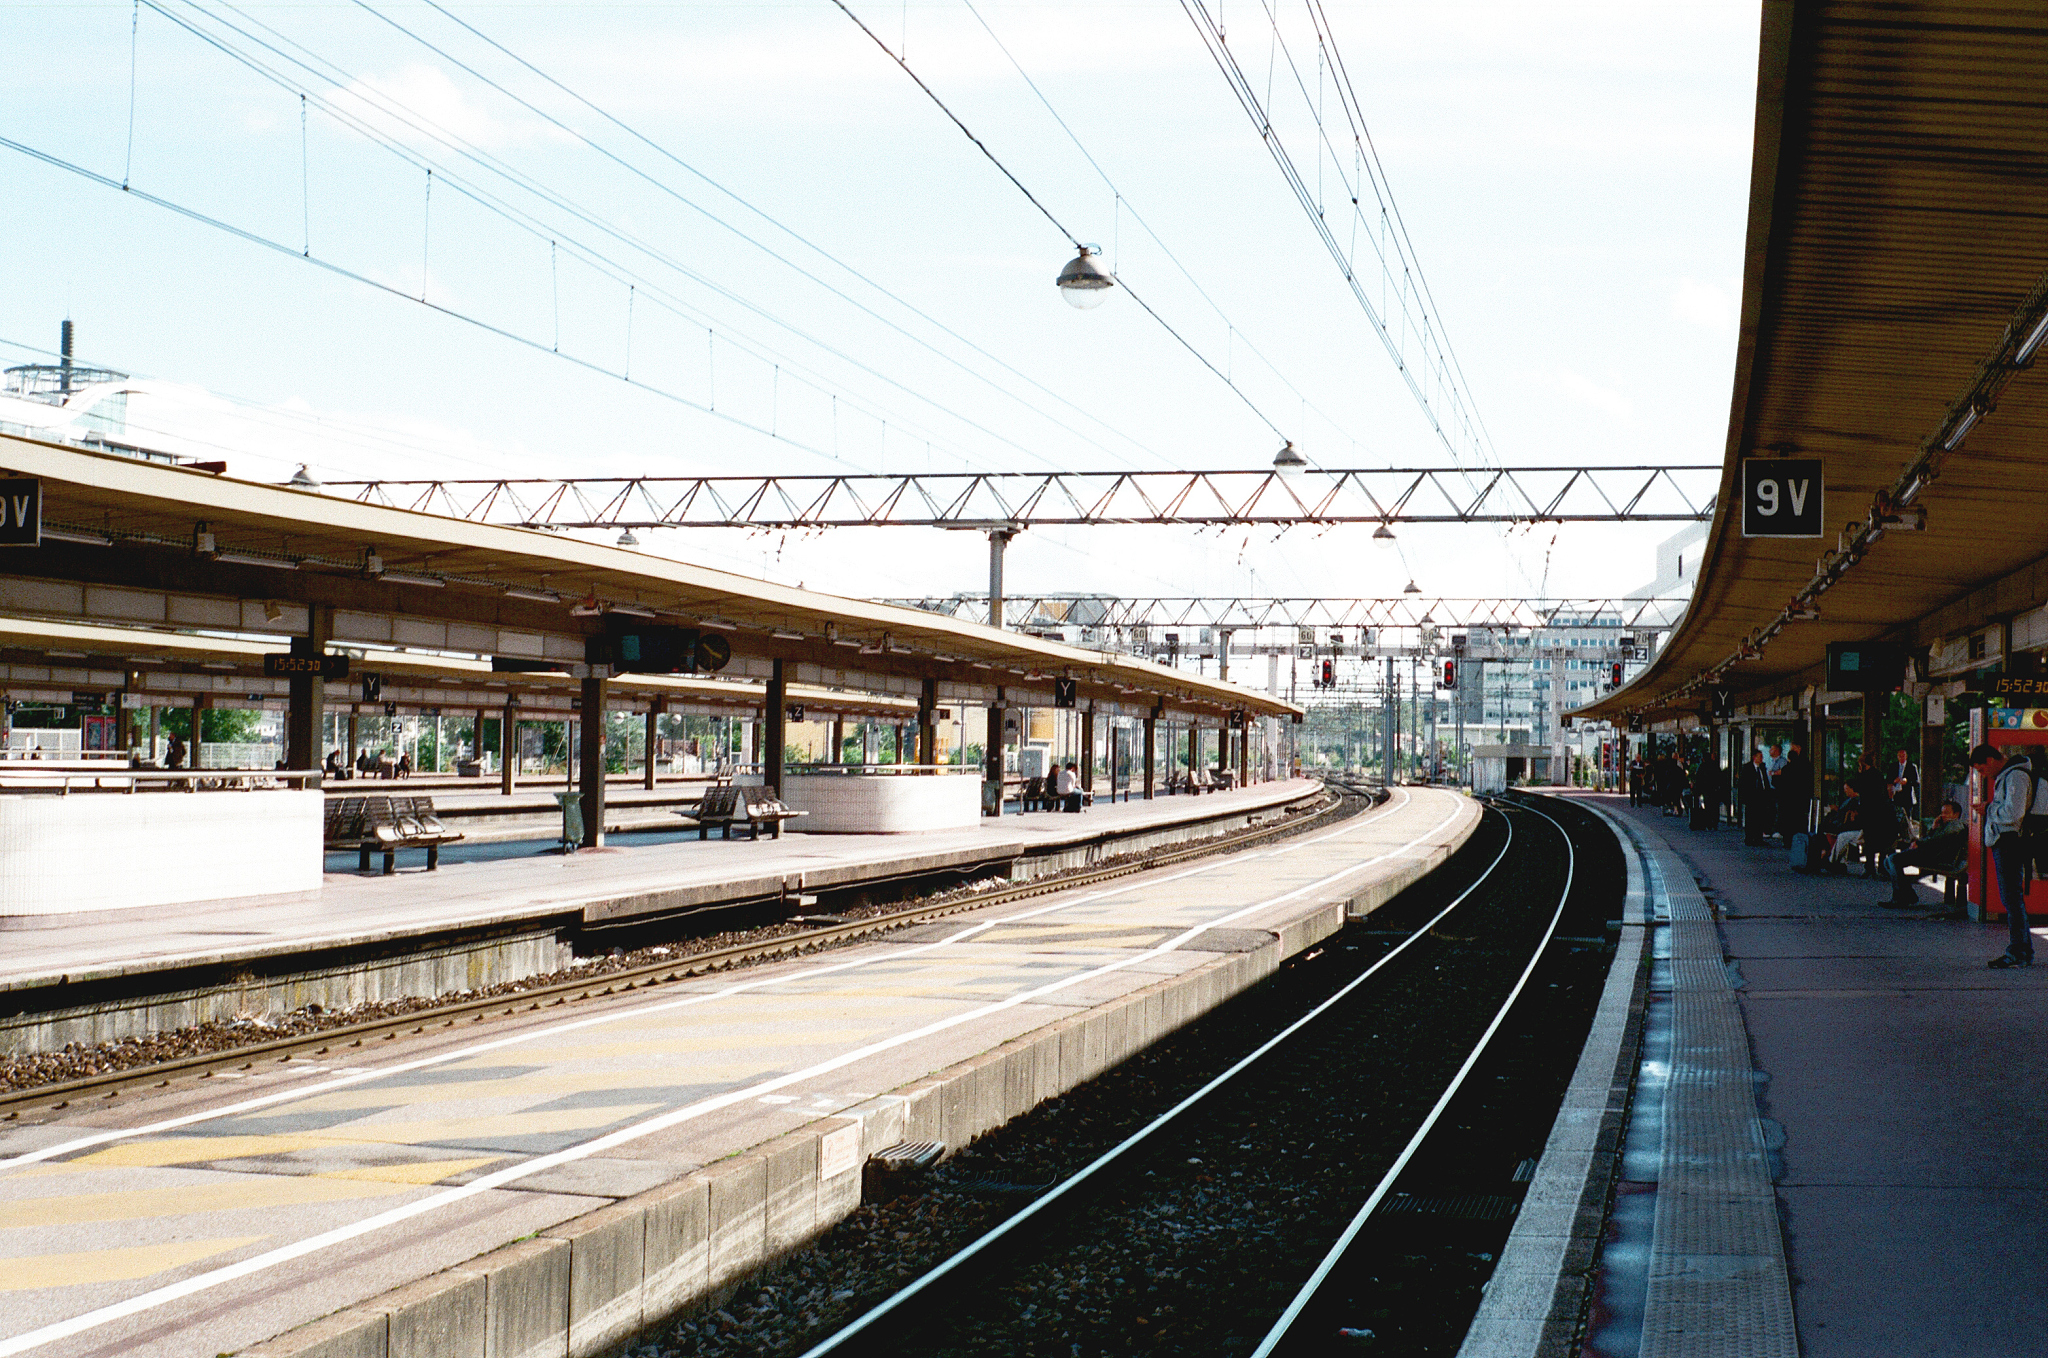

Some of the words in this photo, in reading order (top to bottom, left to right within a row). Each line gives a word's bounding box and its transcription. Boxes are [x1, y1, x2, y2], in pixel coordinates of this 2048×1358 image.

[1133, 629, 1145, 639] 60
[1300, 630, 1312, 640] 60
[1422, 631, 1434, 641] 60
[1637, 649, 1646, 659] Z
[367, 677, 377, 691] Y
[1061, 681, 1071, 697] Y
[1996, 678, 2033, 693] 15:52
[1718, 690, 1729, 706] Y
[794, 706, 802, 717] Z
[1233, 711, 1241, 723] Z
[1632, 715, 1639, 725] Z
